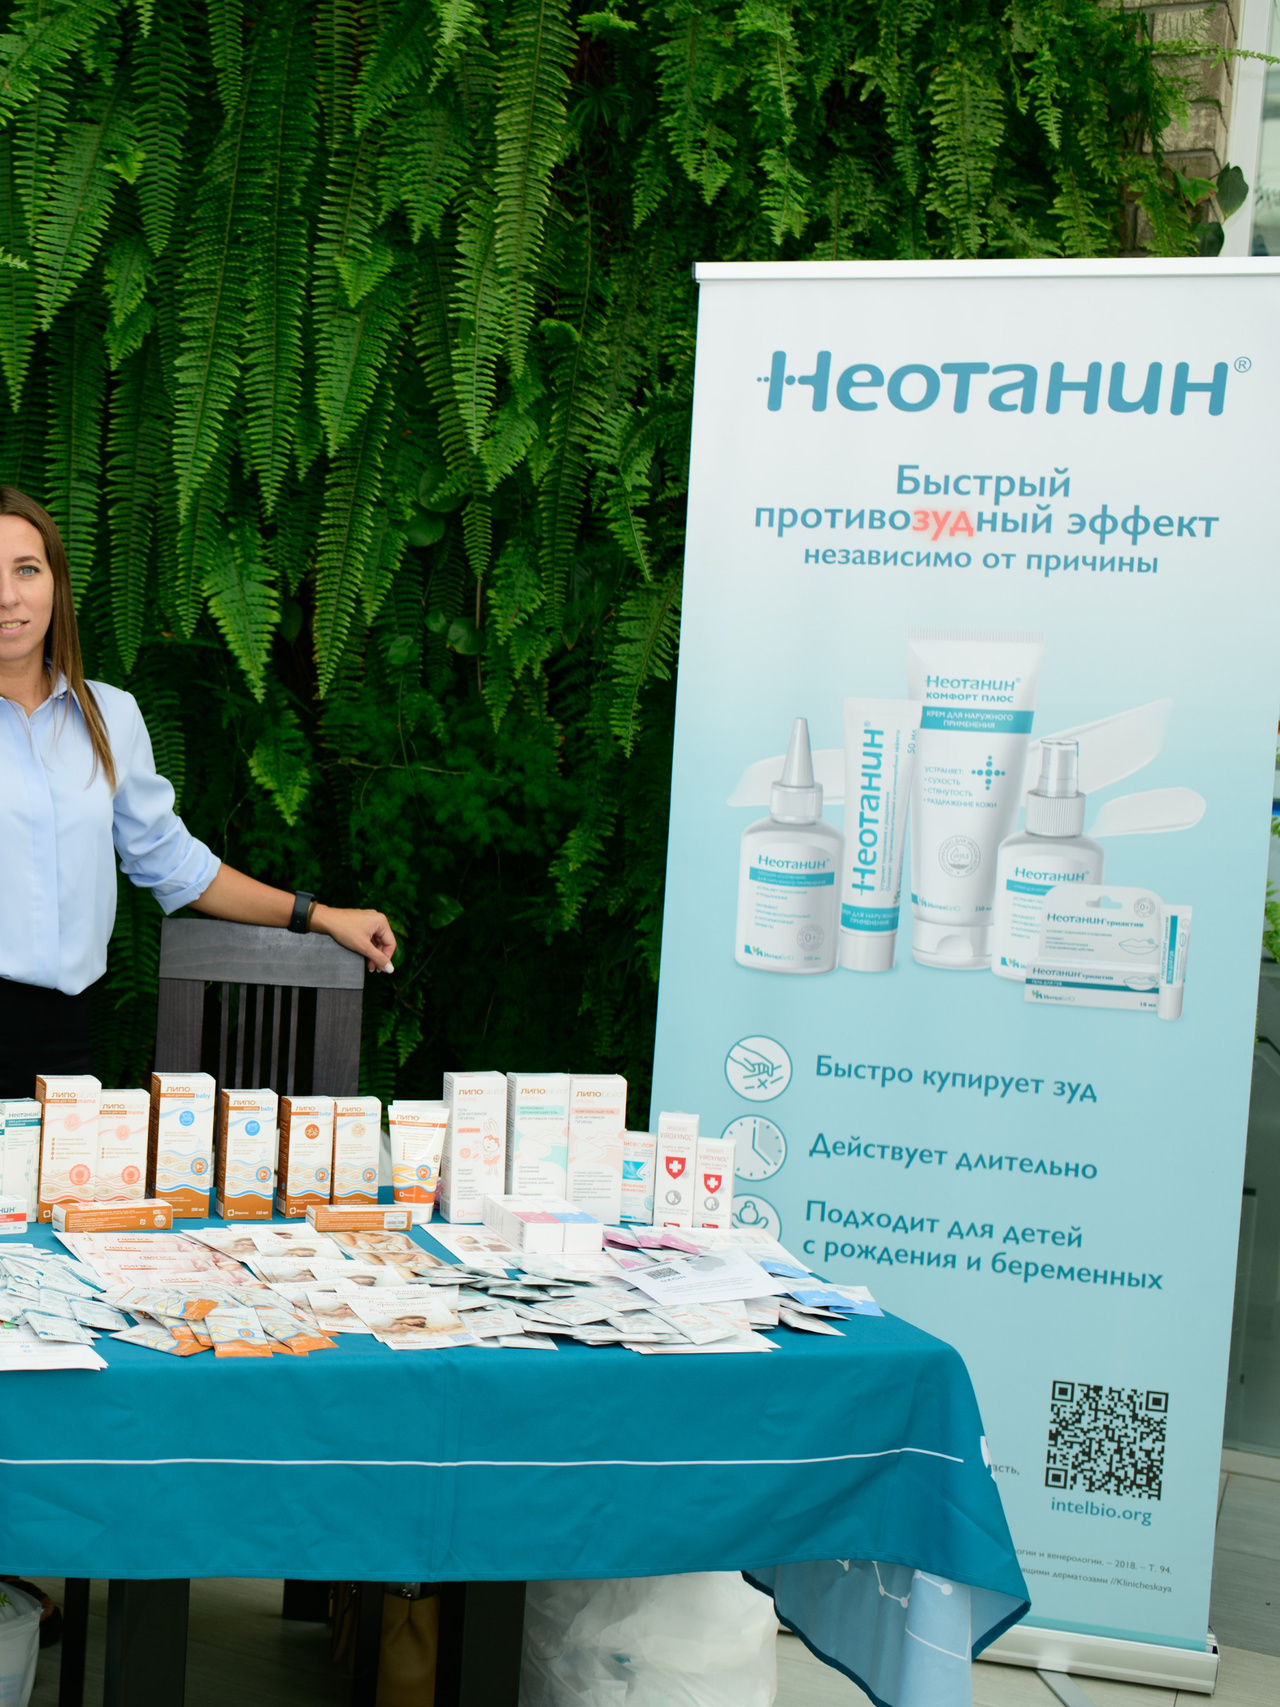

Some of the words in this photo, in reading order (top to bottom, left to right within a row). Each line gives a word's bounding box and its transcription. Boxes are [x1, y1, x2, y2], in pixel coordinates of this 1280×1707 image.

[896, 464, 1071, 505] Быстрый
[755, 503, 1053, 541] противозудный
[1067, 504, 1219, 545] эффект
[804, 546, 972, 569] независимо
[982, 551, 1016, 570] от
[1026, 553, 1158, 577] причины
[926, 692, 978, 702] КОМФОРТ
[981, 694, 1014, 703] ПЛЮС
[815, 1054, 913, 1088] Быстро
[922, 1066, 1044, 1098] купирует
[1052, 1080, 1098, 1103] зуд
[809, 1132, 948, 1169] Действует
[955, 1152, 1098, 1180] длительно
[806, 1200, 939, 1234] Подходит
[947, 1220, 994, 1239] для
[1002, 1225, 1082, 1249] детей
[802, 1241, 816, 1255] с
[823, 1241, 957, 1270] рождения
[966, 1254, 981, 1271] и
[991, 1251, 1164, 1291] беременных
[1051, 1497, 1152, 1526] intelbio.org
[1114, 1559, 1138, 1570] 2018.
